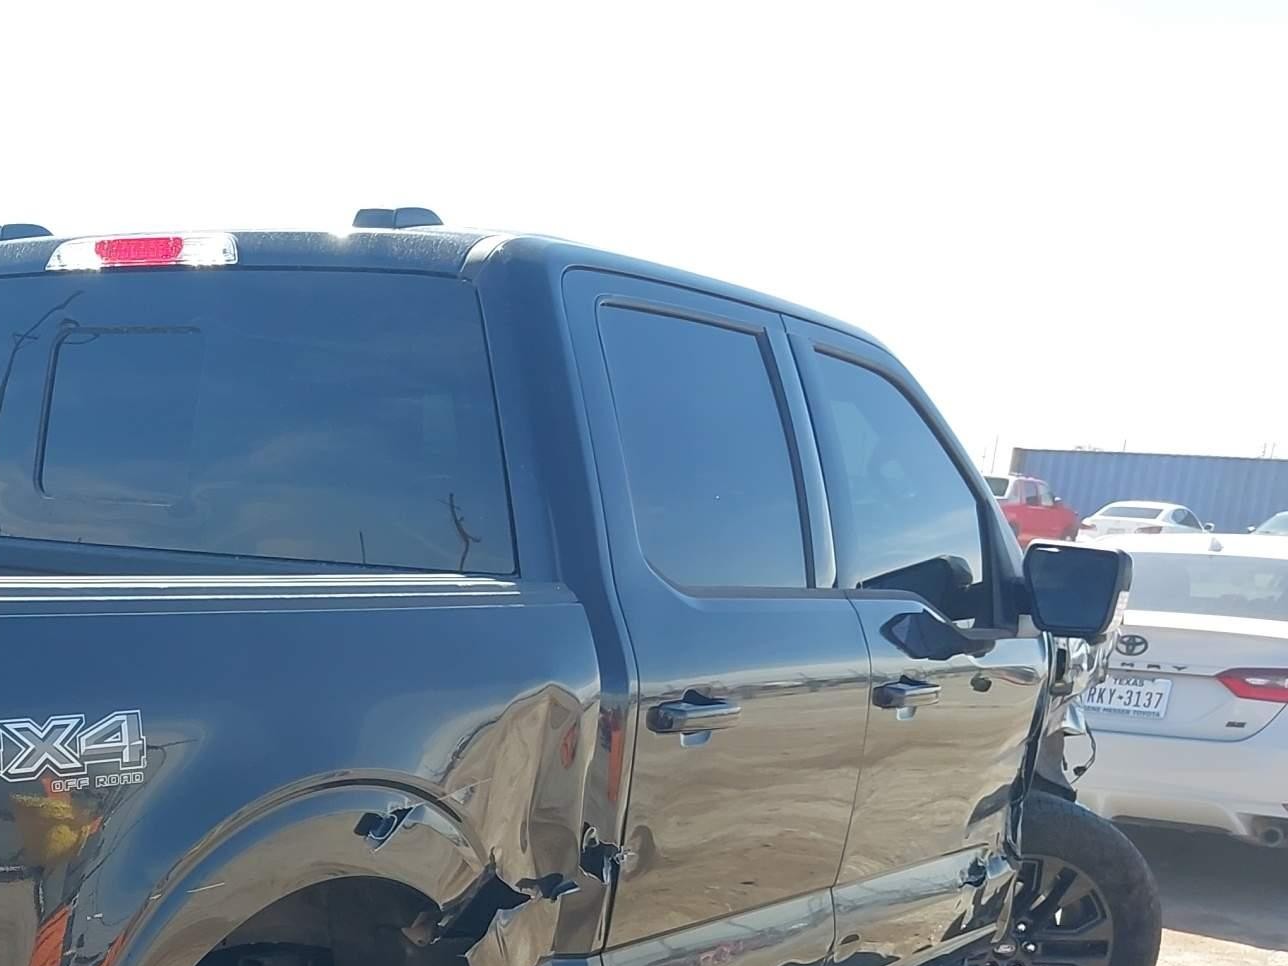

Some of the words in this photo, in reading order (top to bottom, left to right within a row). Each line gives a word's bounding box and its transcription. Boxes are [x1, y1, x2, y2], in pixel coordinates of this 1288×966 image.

[1113, 678, 1145, 687] TEXAS
[51, 777, 91, 793] OFF
[95, 771, 144, 788] ROAD
